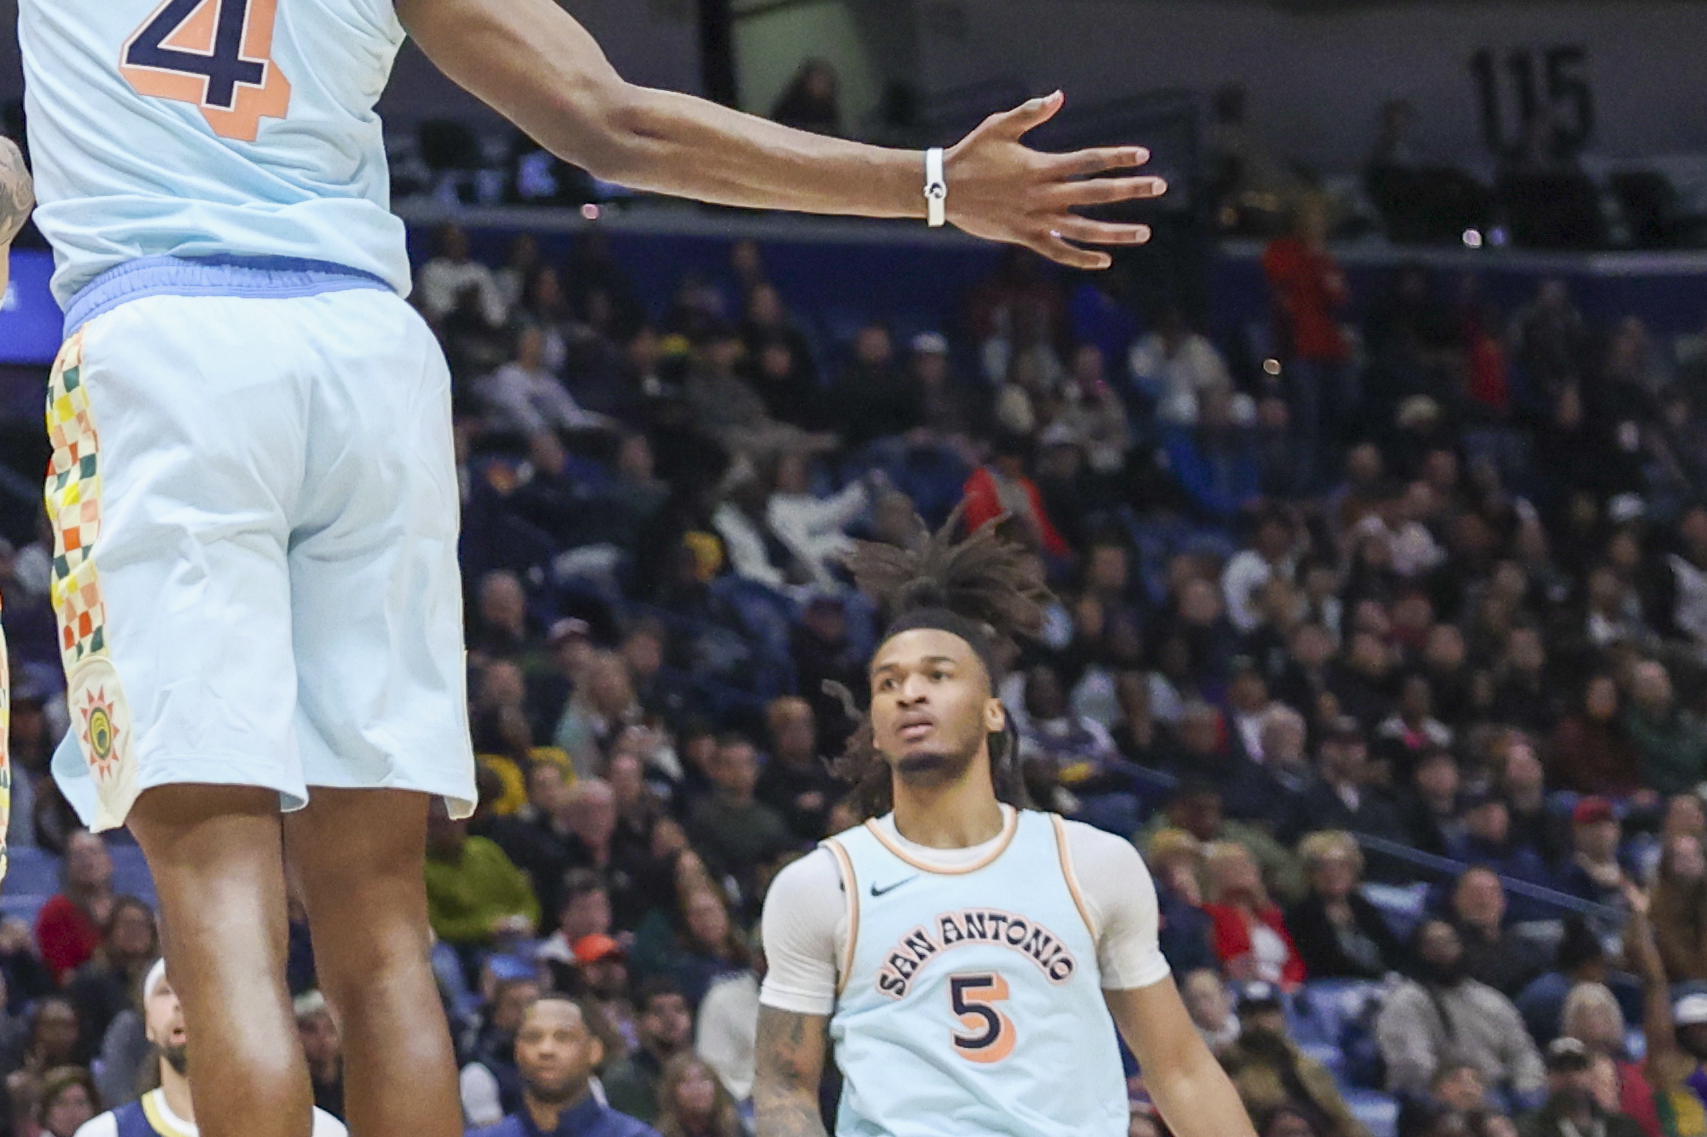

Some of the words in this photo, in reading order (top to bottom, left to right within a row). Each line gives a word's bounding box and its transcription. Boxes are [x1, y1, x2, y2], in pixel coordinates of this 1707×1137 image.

[877, 928, 940, 999] SAN
[937, 911, 1076, 983] ANTONIO
[949, 973, 1007, 1054] 5
